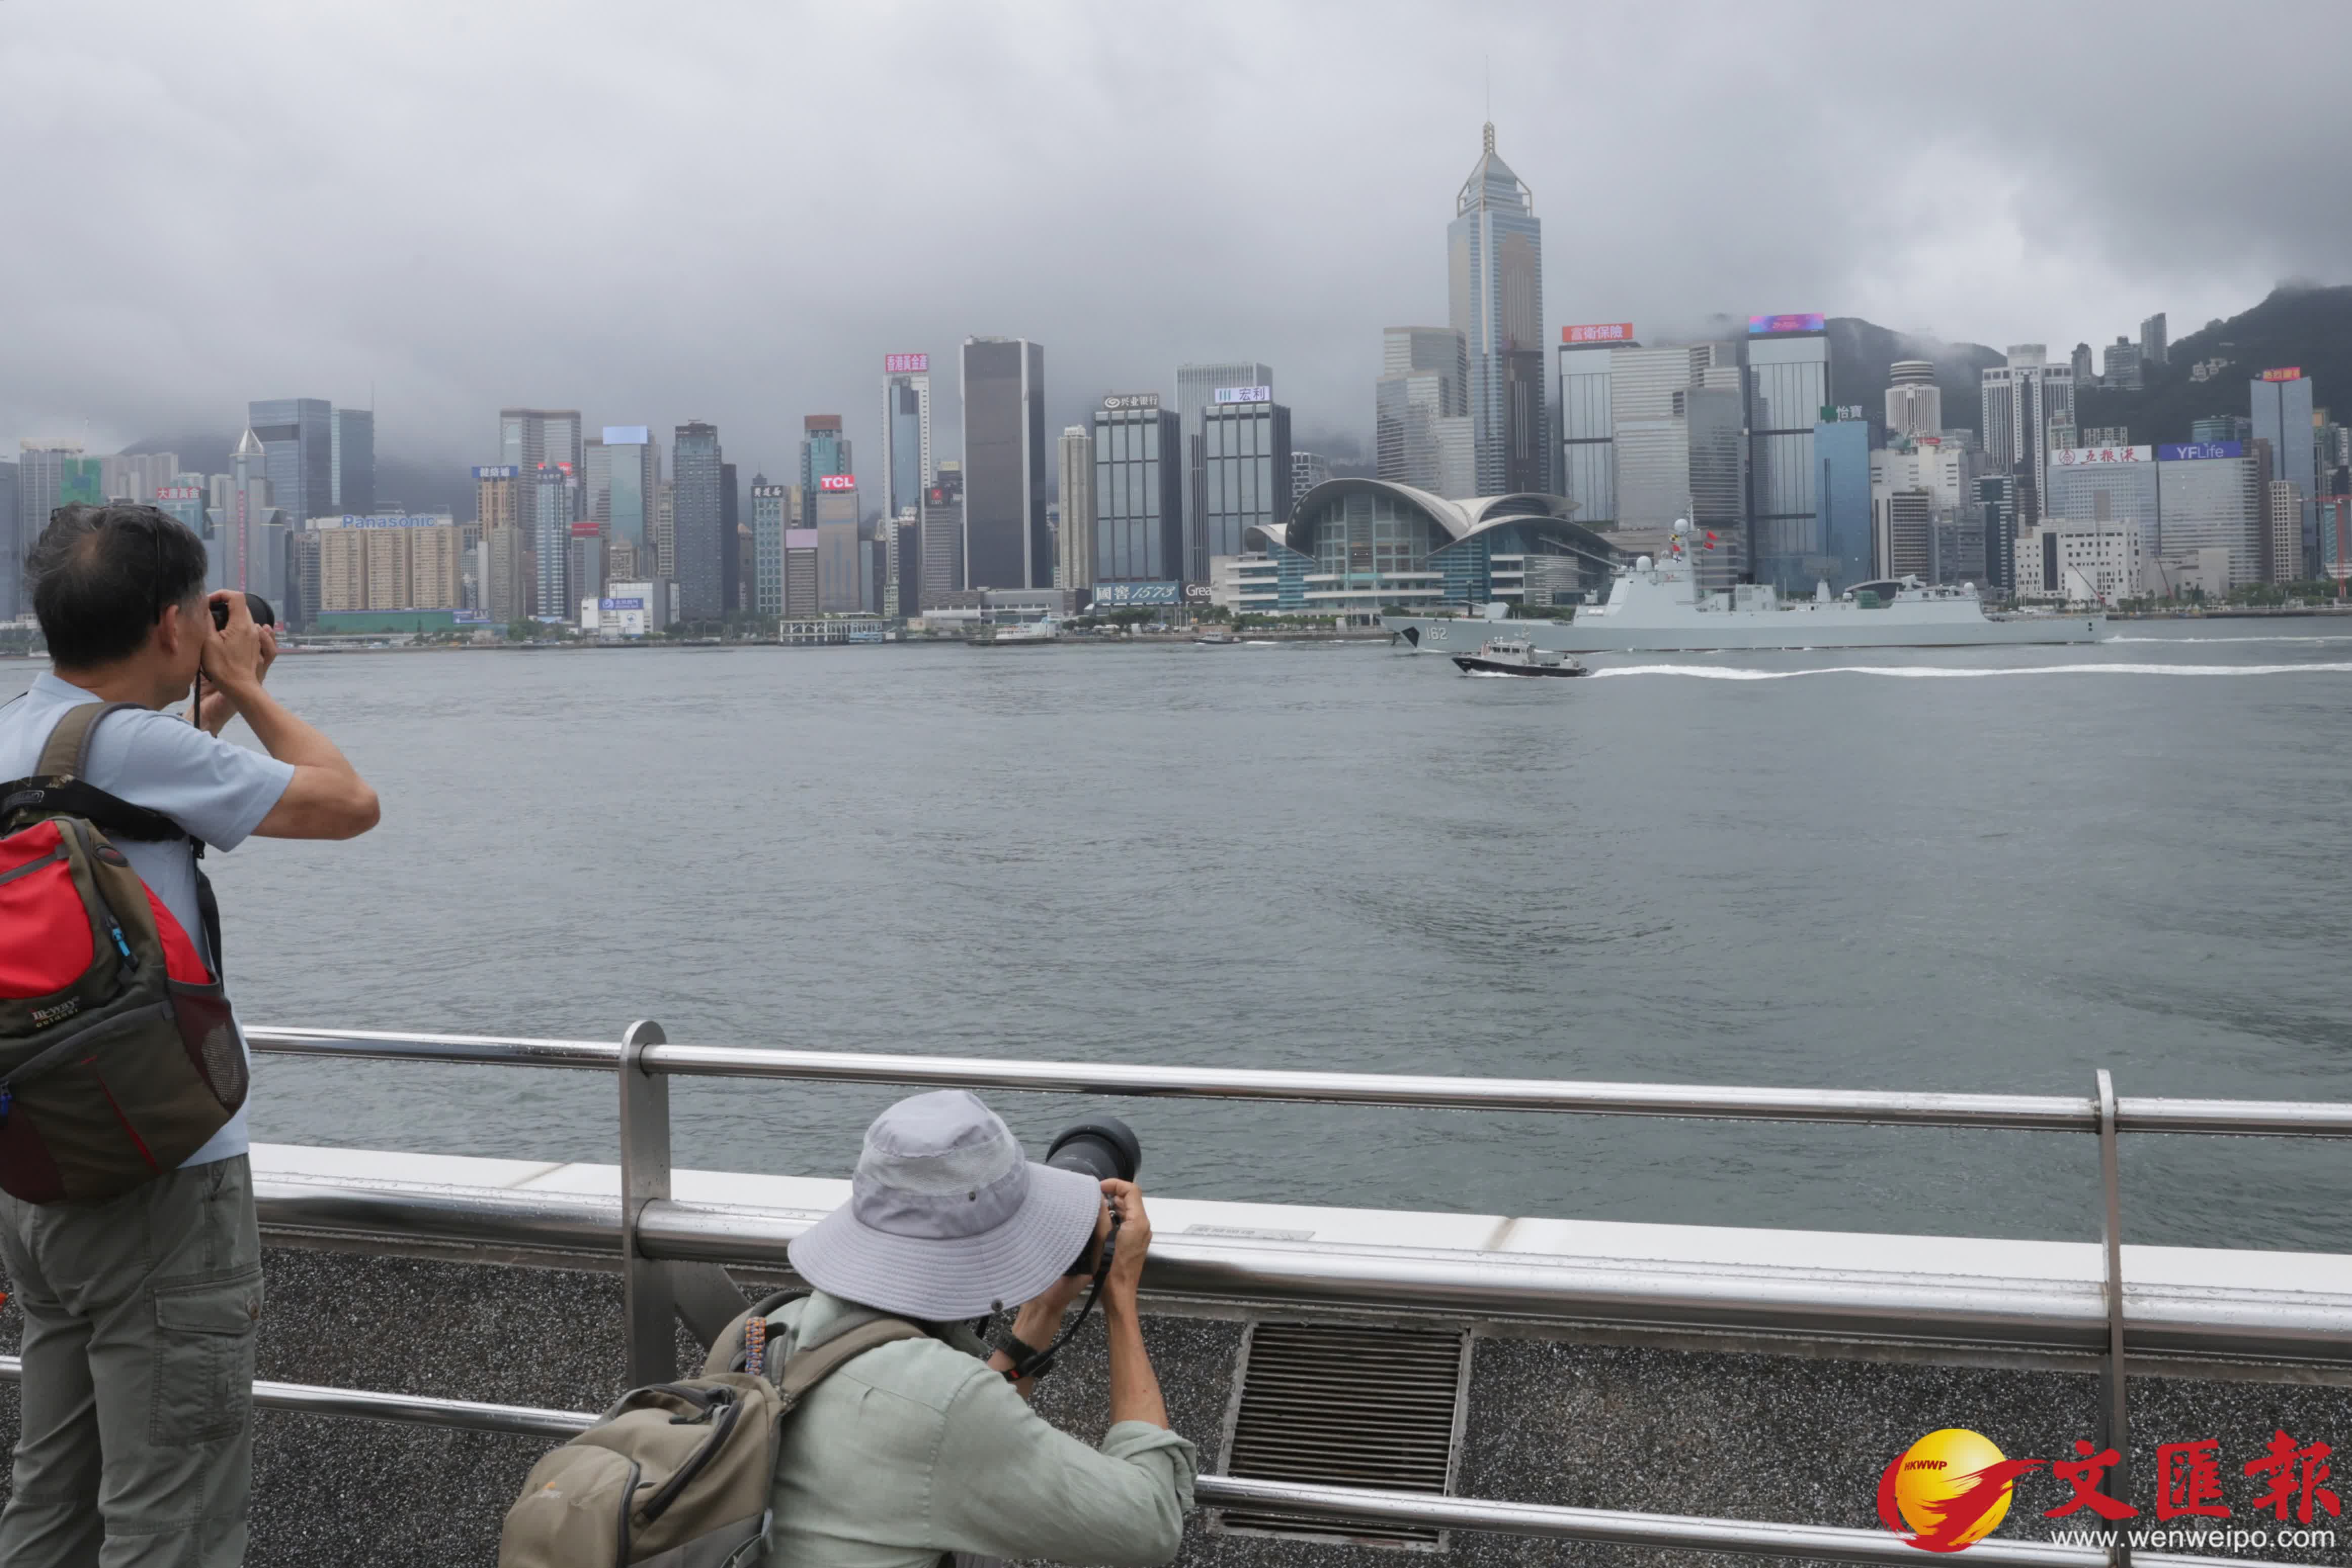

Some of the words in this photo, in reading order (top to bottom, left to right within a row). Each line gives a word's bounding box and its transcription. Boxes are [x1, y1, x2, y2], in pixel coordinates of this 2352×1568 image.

[1571, 325, 1623, 341] 富衛保險
[1239, 387, 1265, 401] 宏利
[2177, 444, 2223, 460] YFLife
[822, 477, 853, 487] TCL
[342, 513, 435, 528] Panasonic
[1426, 627, 1448, 640] 162
